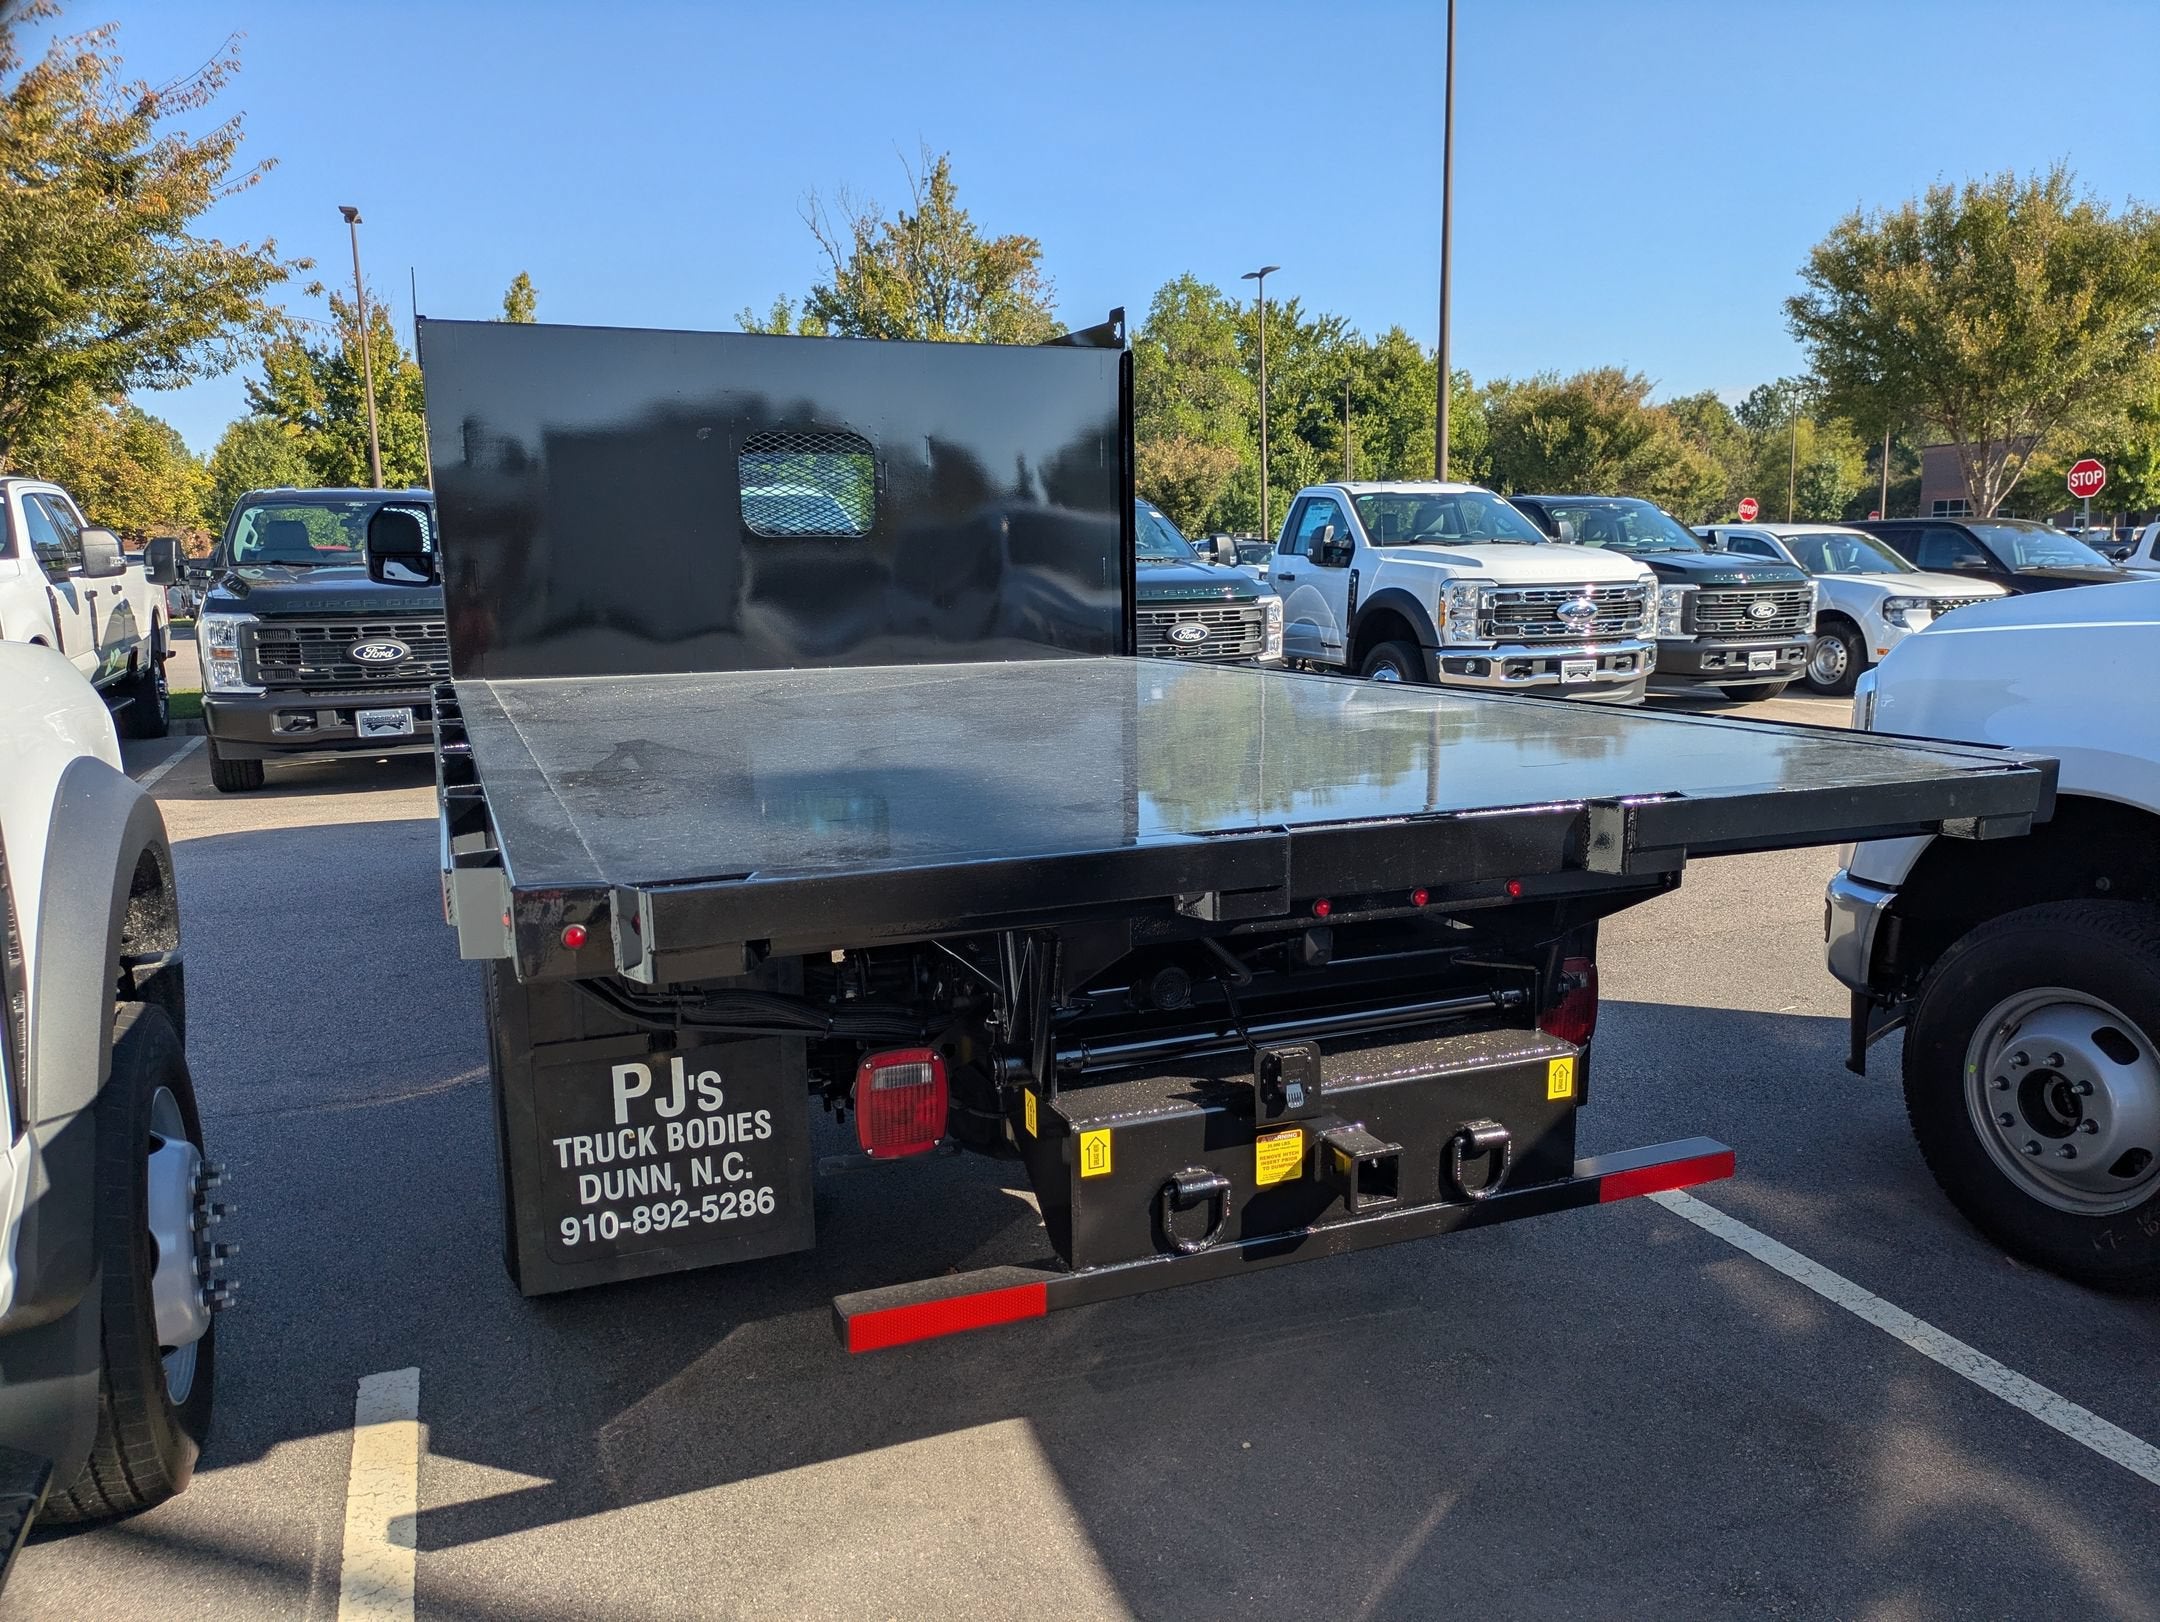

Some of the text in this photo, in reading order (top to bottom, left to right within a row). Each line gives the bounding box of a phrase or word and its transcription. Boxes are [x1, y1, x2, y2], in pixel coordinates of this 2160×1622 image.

[2070, 470, 2103, 488] STOP
[1739, 504, 1758, 515] STOP
[386, 597, 443, 607] DUT
[361, 645, 395, 659] Ford
[553, 1109, 772, 1168] TRUCK BODIES
[578, 1152, 753, 1205] DUNN, N.C.
[560, 1186, 776, 1246] 910-892-5286
